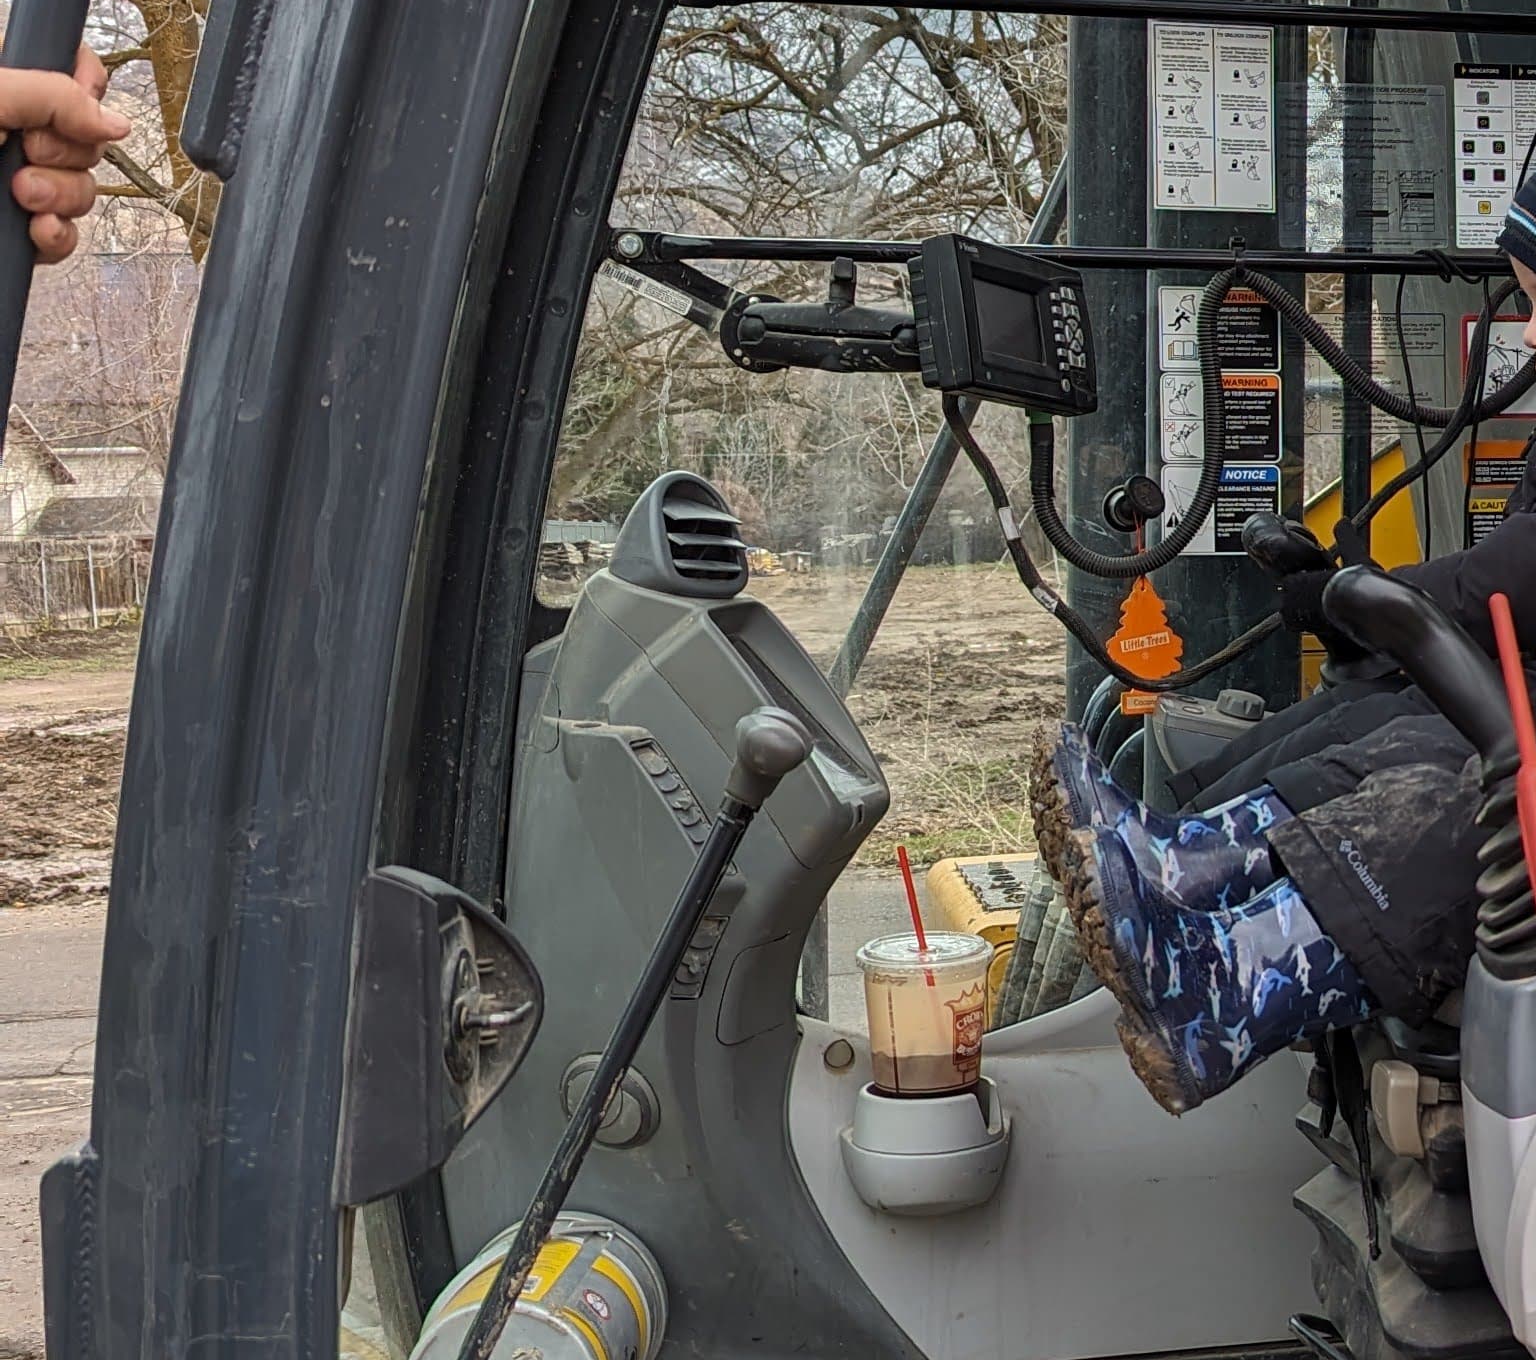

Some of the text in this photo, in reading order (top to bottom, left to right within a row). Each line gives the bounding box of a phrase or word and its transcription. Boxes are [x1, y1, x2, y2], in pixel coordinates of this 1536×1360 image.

[1223, 378, 1268, 387] WARNING
[1225, 470, 1267, 480] NOTICE
[1480, 502, 1506, 510] CAUT
[1123, 633, 1169, 651] Little Trees
[1347, 850, 1390, 911] Columbia
